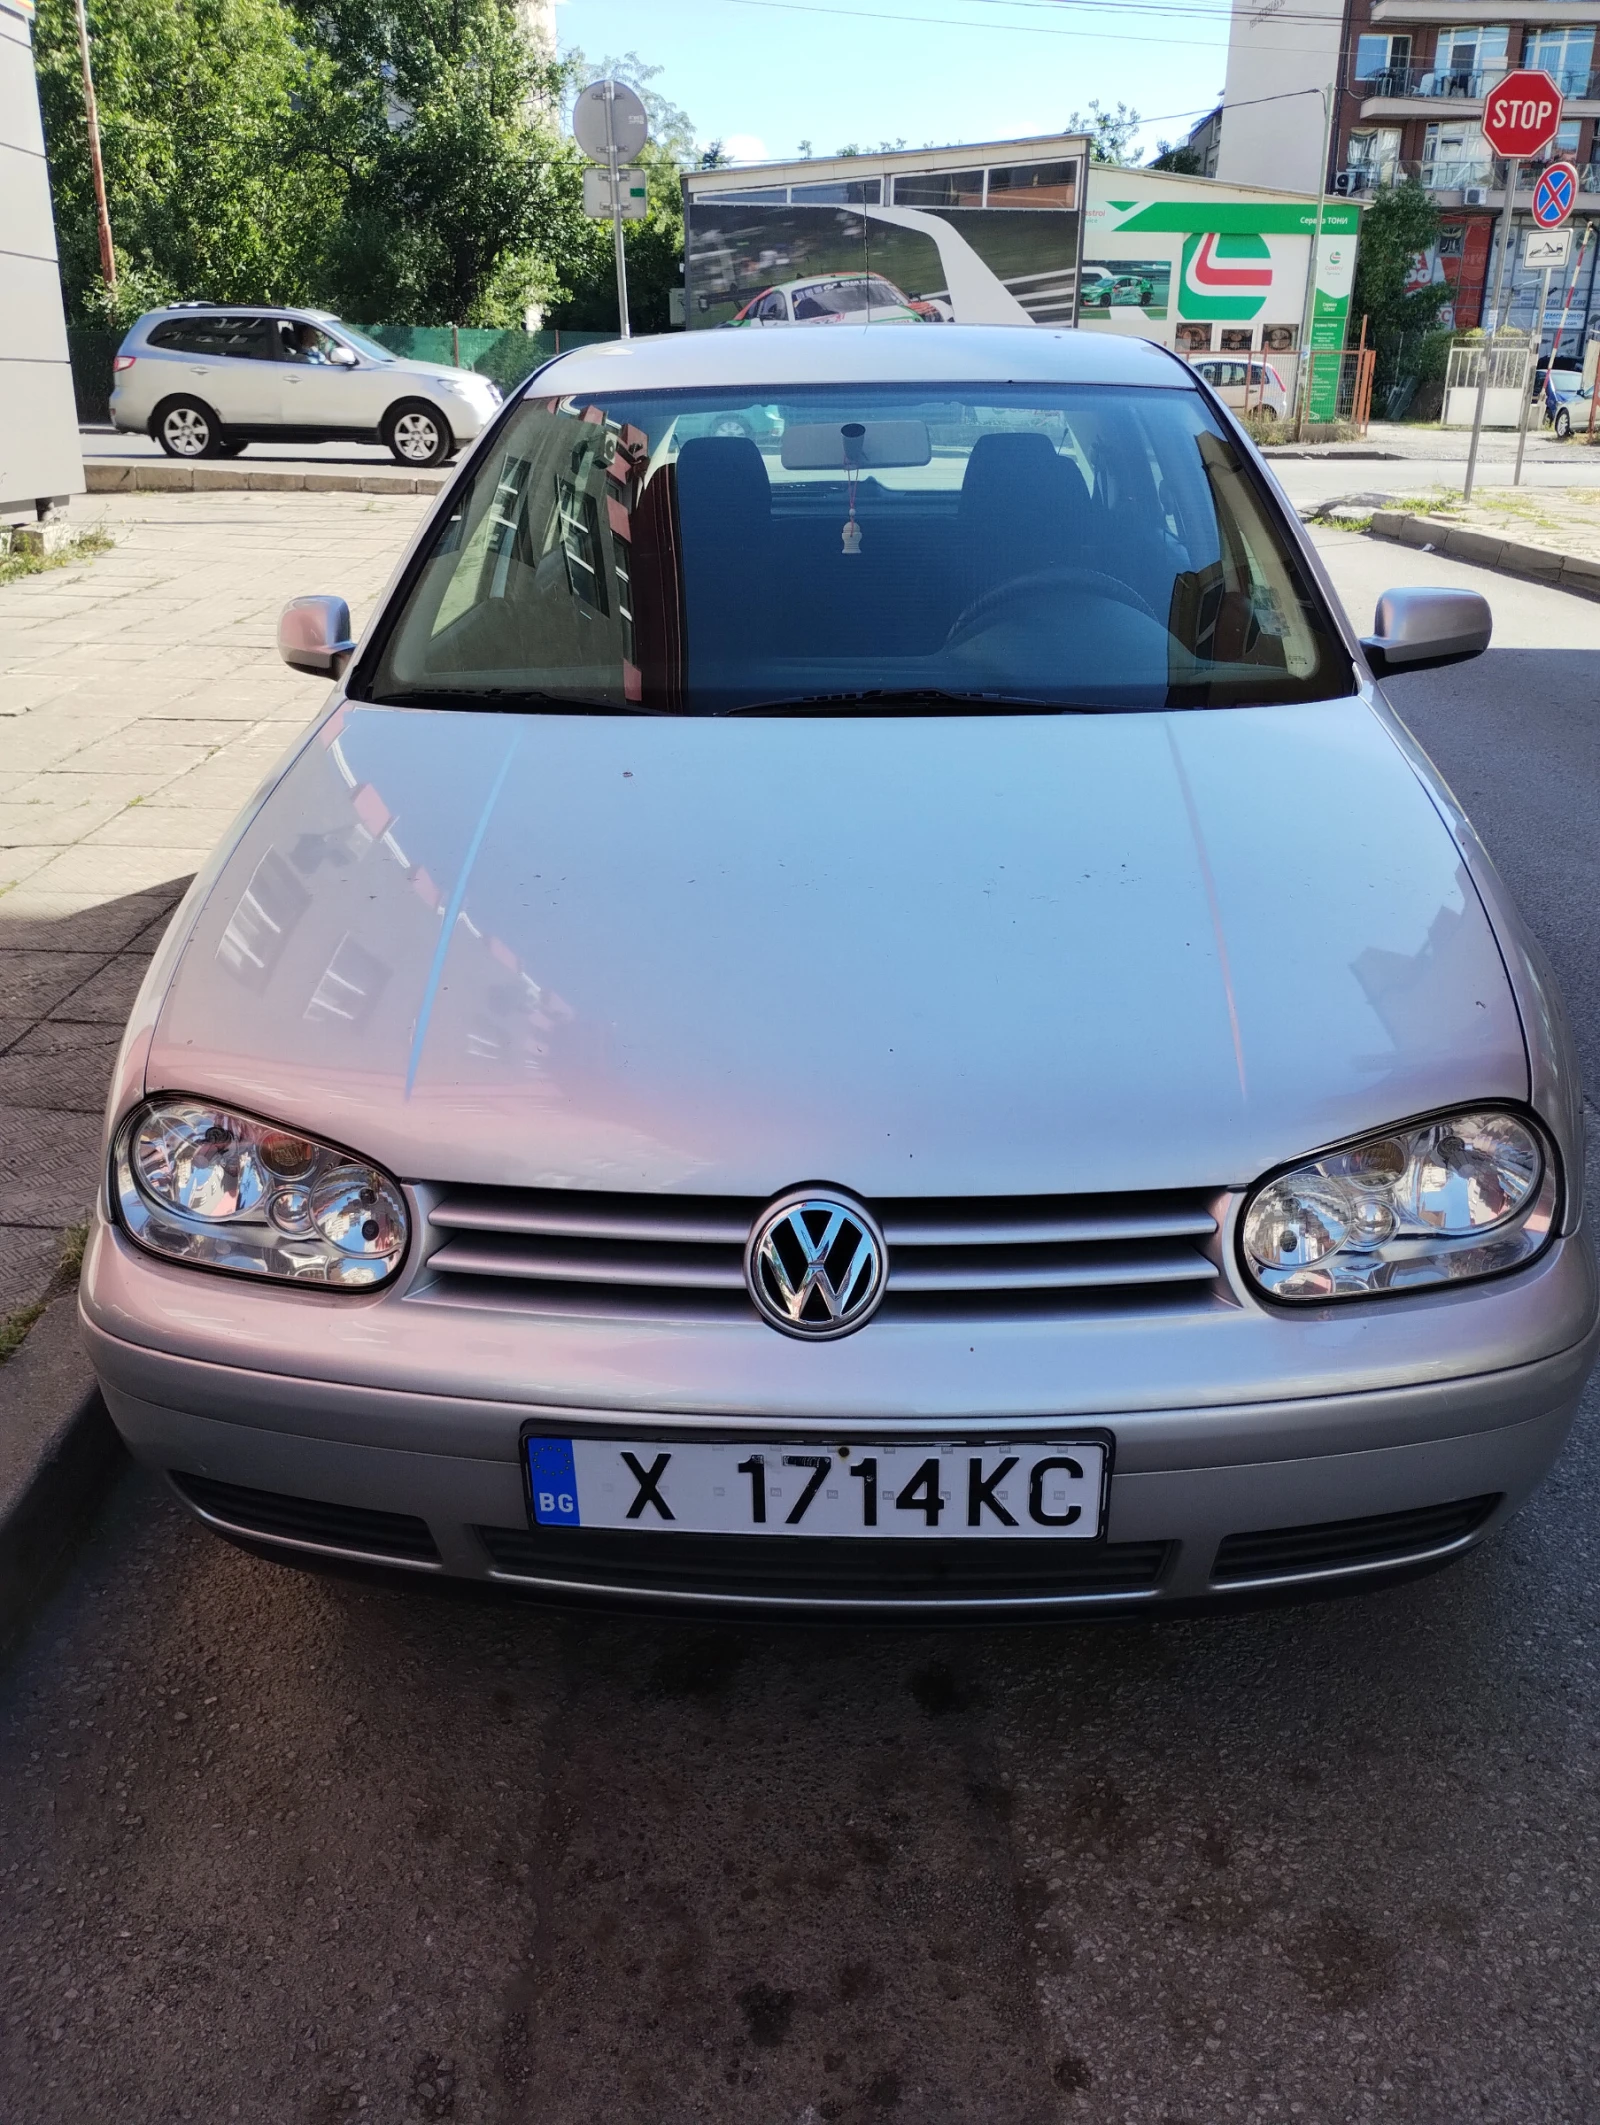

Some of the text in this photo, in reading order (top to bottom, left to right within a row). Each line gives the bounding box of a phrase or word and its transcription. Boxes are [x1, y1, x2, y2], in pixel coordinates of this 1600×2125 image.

[1492, 99, 1553, 130] STOP
[1083, 209, 1106, 217] astrol
[1327, 216, 1348, 225] ТОНИ
[620, 1451, 676, 1520] X
[539, 1492, 574, 1513] BG
